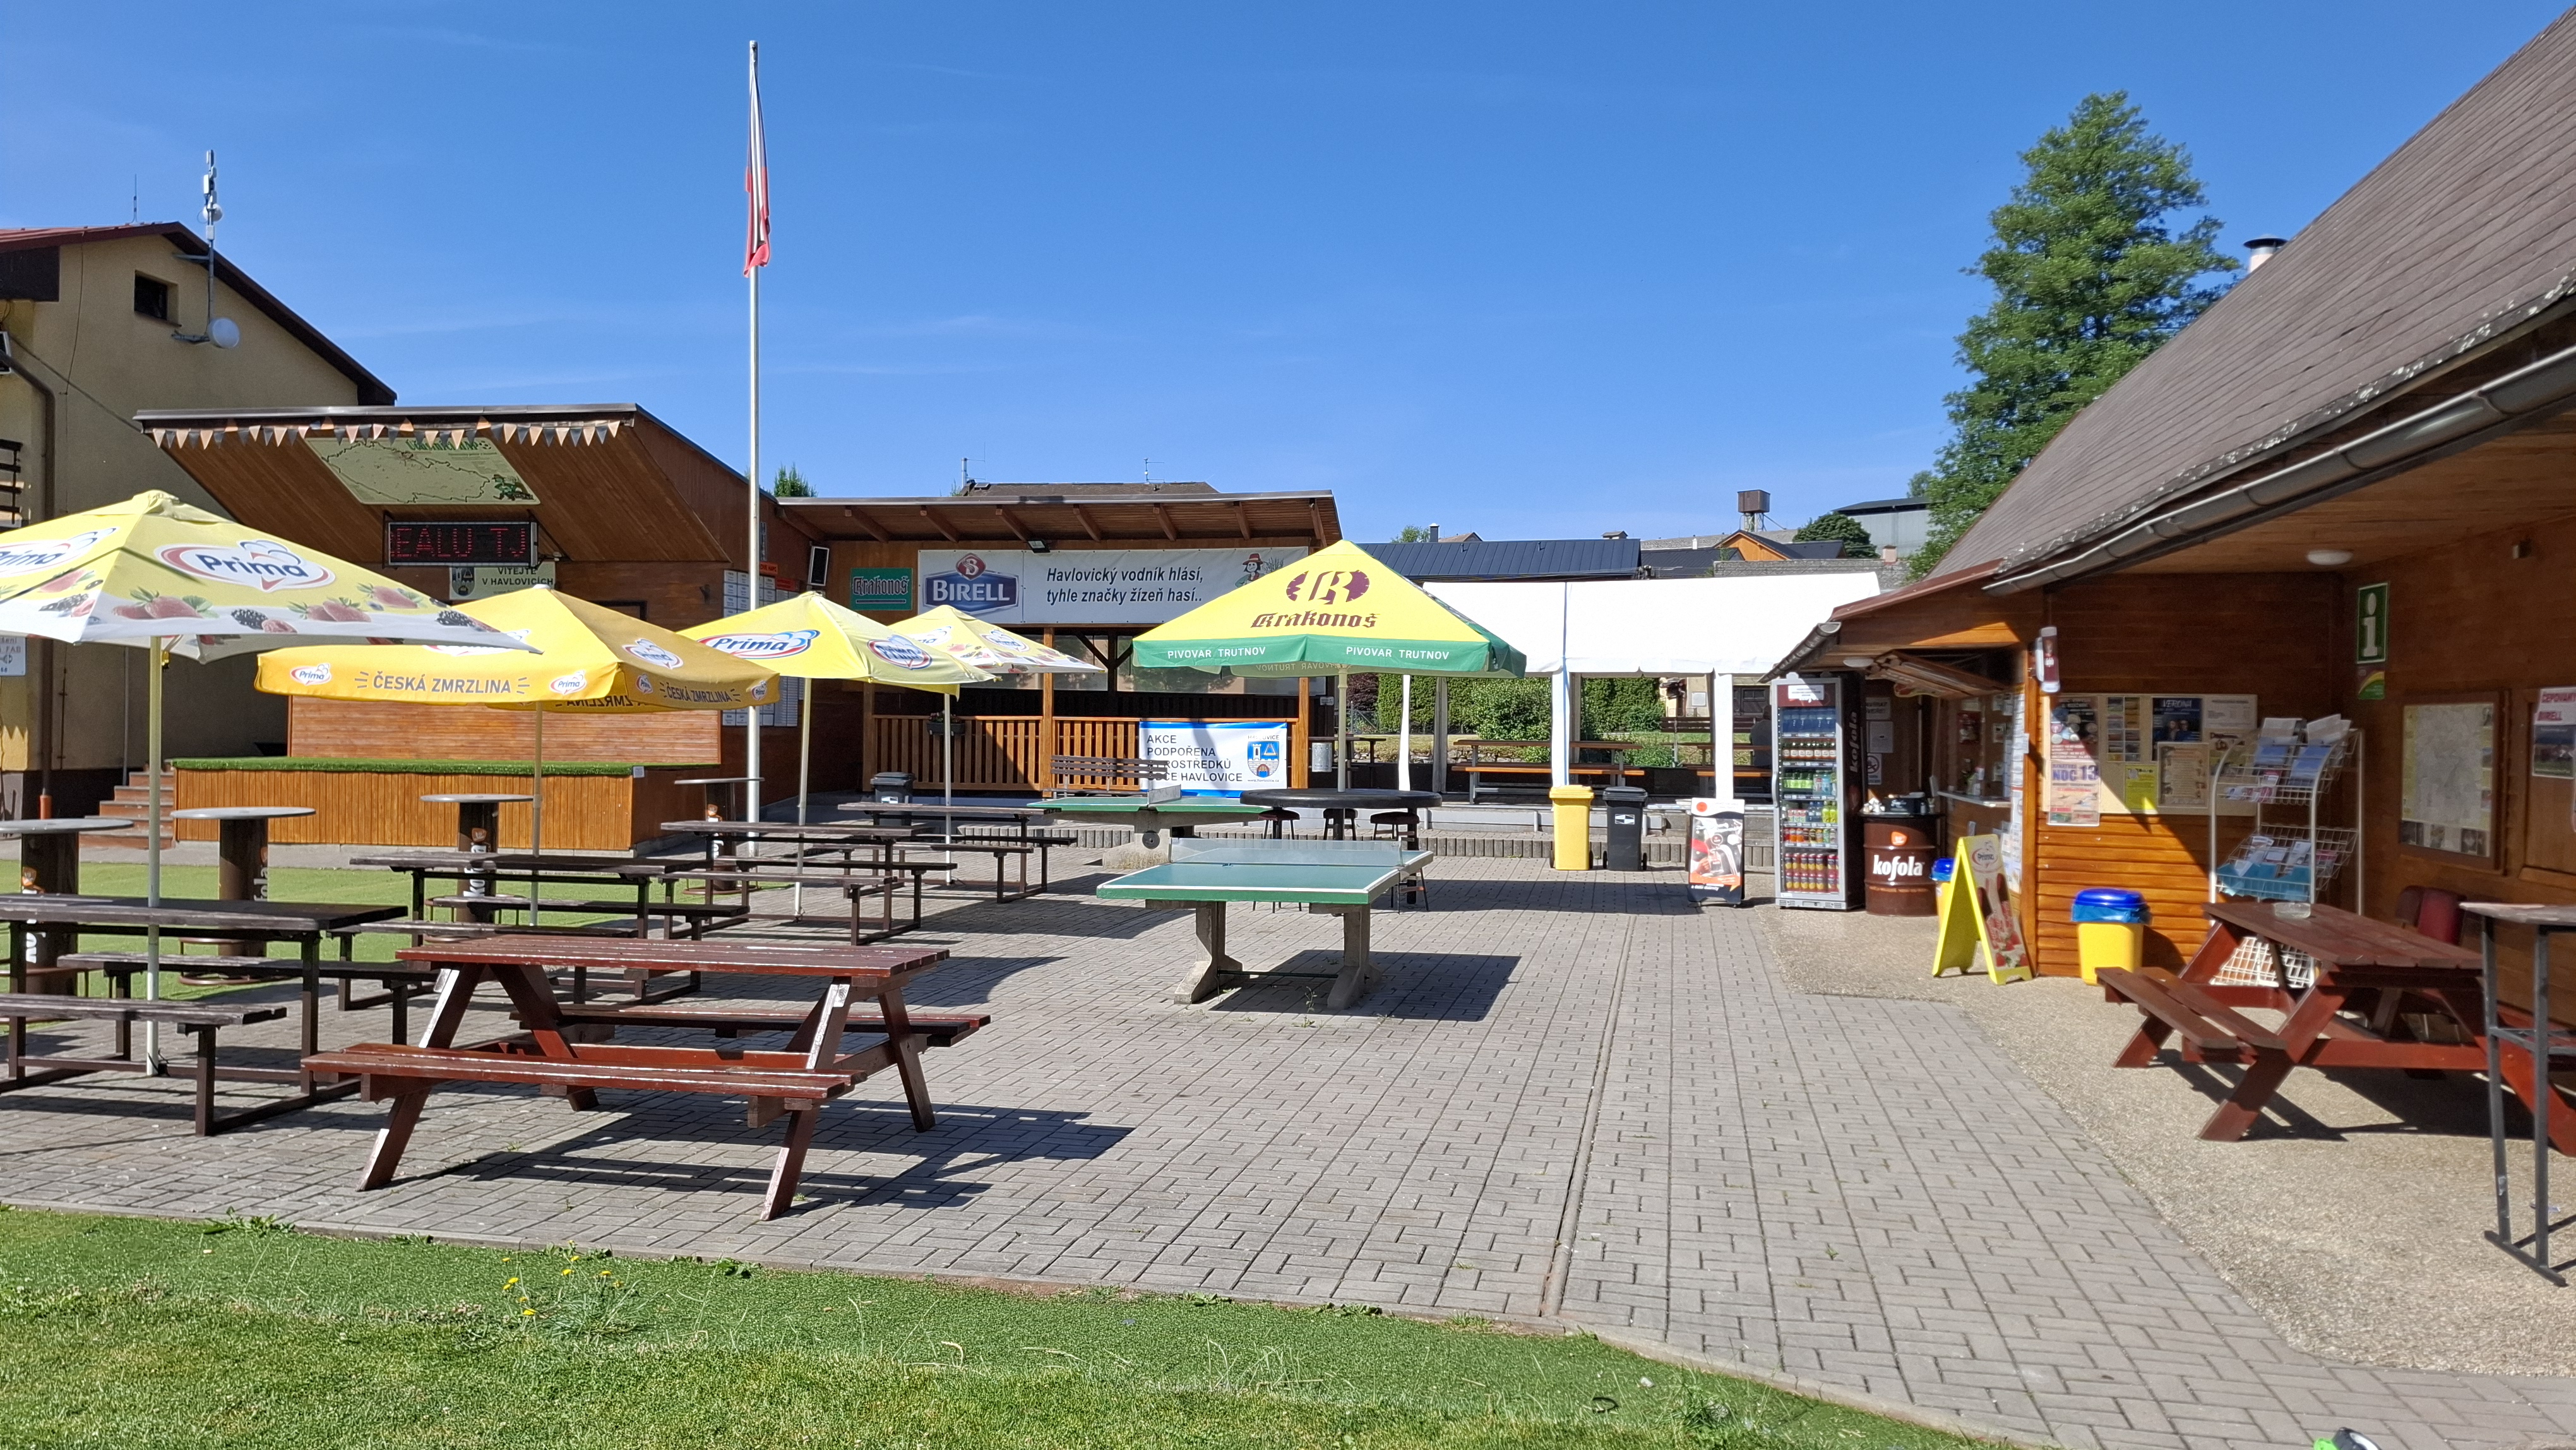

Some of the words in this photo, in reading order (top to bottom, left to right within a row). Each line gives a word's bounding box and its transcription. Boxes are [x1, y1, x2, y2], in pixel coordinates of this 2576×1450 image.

[490, 528, 526, 557] TJ
[195, 553, 309, 577] Prima
[491, 577, 554, 585] HAVLOVICÍCH
[1047, 567, 1118, 585] Havlovický
[1121, 566, 1165, 582] vodník
[1169, 566, 1203, 583] hlásí,
[853, 575, 910, 596] Krakonoš
[933, 580, 1010, 601] BIRELL
[1047, 588, 1078, 606] tyhle
[1082, 588, 1127, 606] značky
[1130, 588, 1163, 602] žízeň
[1167, 587, 1202, 602] hasí..
[1250, 609, 1381, 628] Krakonoš
[713, 638, 790, 651] Prima
[877, 645, 921, 660] Prima
[1168, 649, 1212, 659] PIVOVAR
[1218, 647, 1266, 657] TRUTNOV
[1347, 646, 1392, 658] PIVOVAR
[1399, 649, 1450, 660] TRUTNOV
[299, 671, 325, 681] Prima
[373, 671, 427, 692] ČESKÁ
[431, 678, 512, 693] ZMRZLINA
[666, 682, 691, 702] ČESKÁ
[691, 690, 732, 702] ZMRZLINA
[1147, 735, 1177, 744] AKCE
[1849, 711, 1859, 773] kofola
[1147, 745, 1216, 757] PODPOŘENA
[1157, 757, 1231, 769] ROSTŘEDKŮ
[1181, 772, 1243, 782] HAVLOVICE
[2079, 765, 2099, 781] 13
[1873, 854, 1923, 880] kofola
